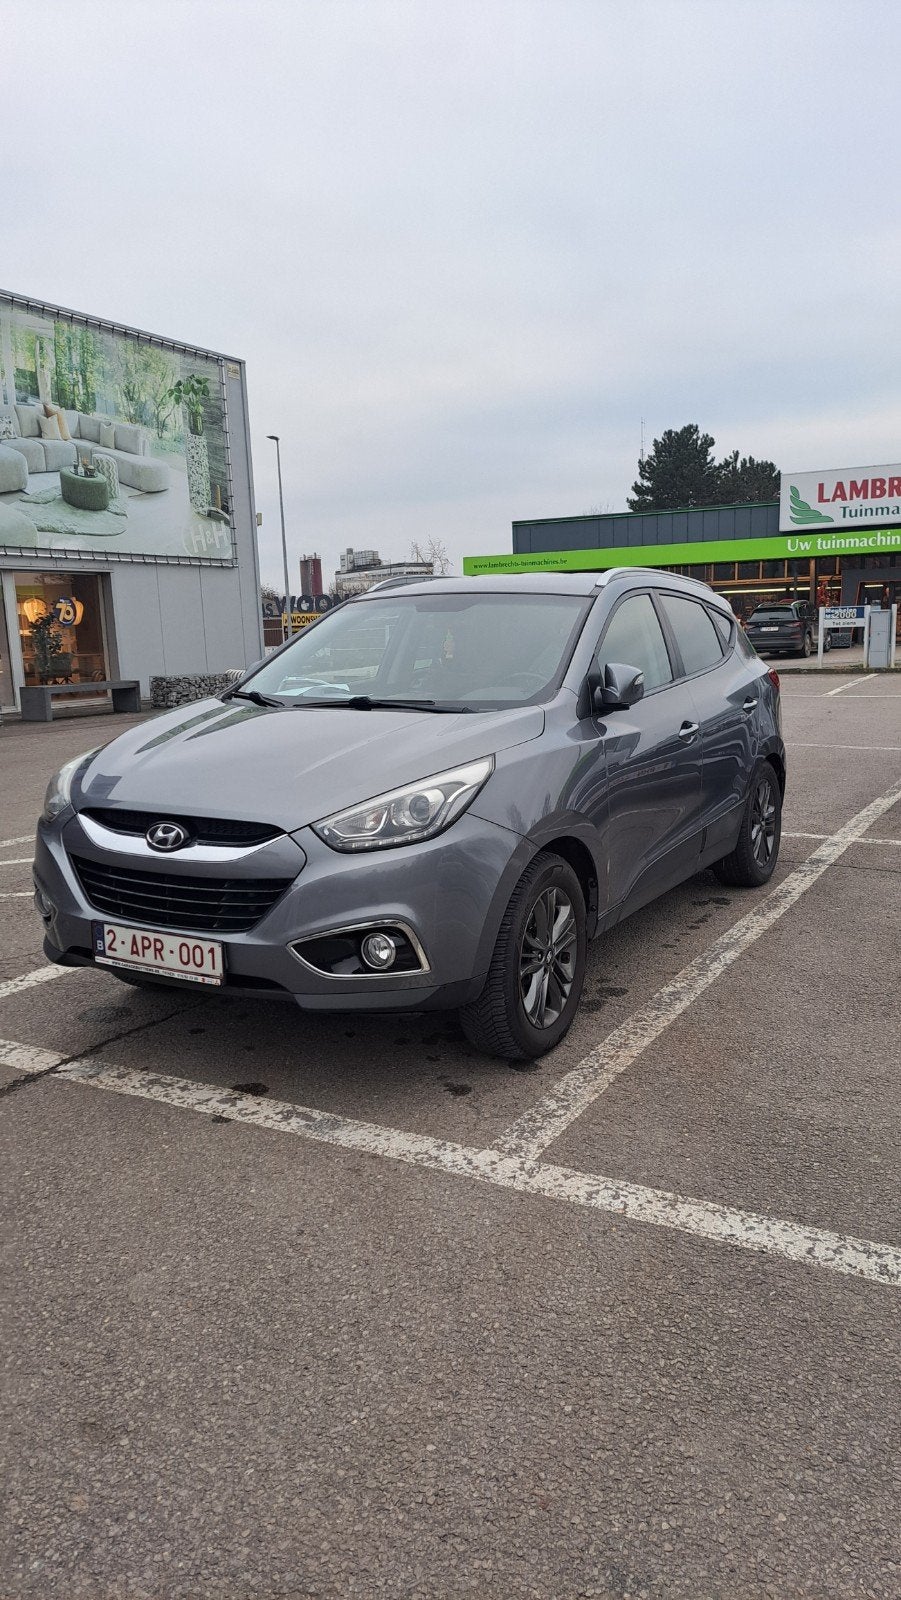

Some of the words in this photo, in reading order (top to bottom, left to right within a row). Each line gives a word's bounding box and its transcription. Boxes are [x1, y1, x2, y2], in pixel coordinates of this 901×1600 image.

[817, 476, 901, 504] LAMBR
[840, 504, 901, 519] Tuinma
[787, 538, 812, 552] Uw
[816, 532, 901, 550] tuinmachin
[473, 558, 568, 569] www.lambrechts-tuinmachines.be
[96, 939, 104, 951] B
